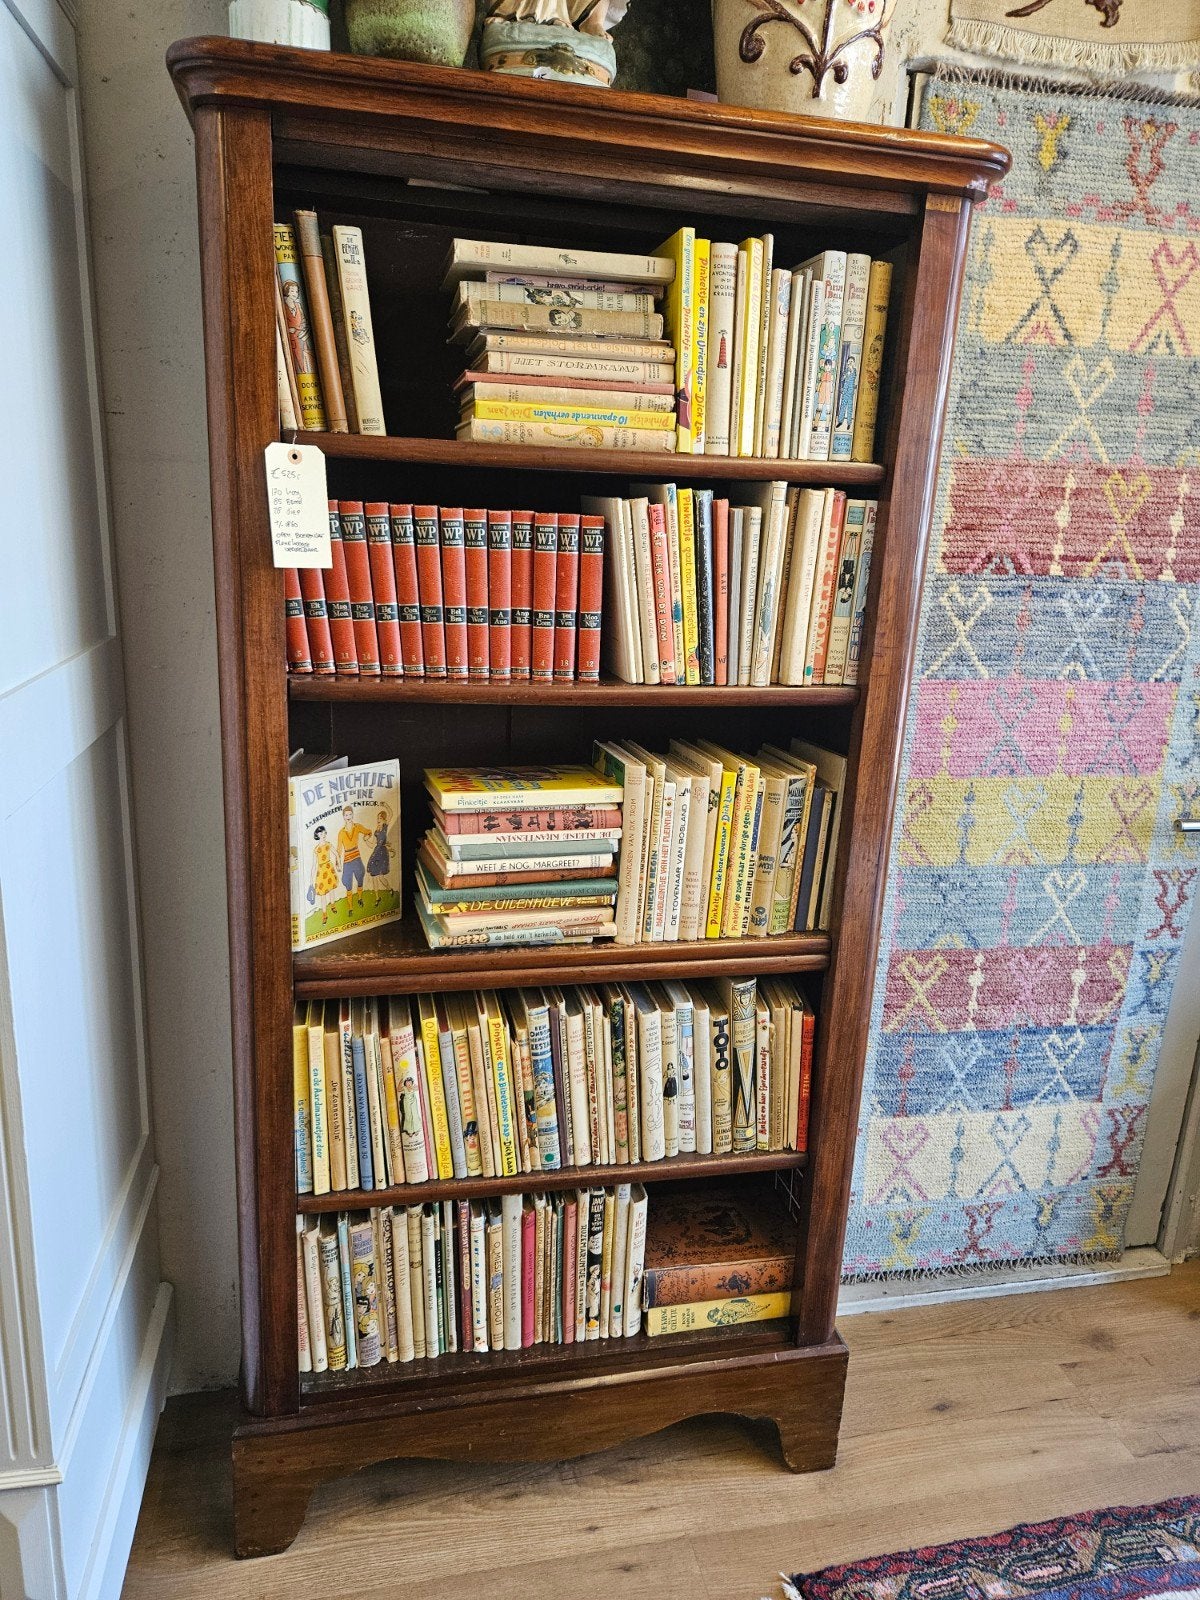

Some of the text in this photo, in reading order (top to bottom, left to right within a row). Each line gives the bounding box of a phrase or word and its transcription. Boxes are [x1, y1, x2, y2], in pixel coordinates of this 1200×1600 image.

[699, 258, 708, 304] Pinkeltje
[683, 308, 691, 350] Pinkeltje
[697, 320, 706, 338] zijn
[695, 393, 705, 418] Dick
[533, 410, 570, 420] verhalen
[571, 412, 618, 423] spannende
[618, 416, 628, 425] 10
[682, 495, 692, 542] Pinkeltje
[343, 522, 363, 533] WP
[369, 524, 388, 535] WP
[394, 525, 413, 536] WP
[416, 527, 436, 538] WP
[444, 528, 462, 539] WP
[466, 529, 485, 540] WP
[491, 530, 509, 542] WP
[515, 531, 532, 542] WP
[537, 533, 555, 545] WP
[560, 534, 578, 545] WP
[584, 535, 602, 546] WP
[683, 547, 691, 566] gaat
[655, 554, 668, 642] HEK VAN DE DAM
[814, 579, 833, 656] TROM
[302, 772, 395, 806] DE NICHTJES
[329, 789, 374, 806] JET INE
[495, 834, 559, 842] KRANTENMAN
[563, 832, 596, 840] KLEINE
[718, 826, 727, 857] tovenaar
[672, 867, 682, 911] TOVENAAR
[678, 804, 688, 844] BOSLAND
[739, 852, 746, 861] de
[499, 863, 506, 871] JE
[660, 859, 668, 874] VAN
[737, 862, 745, 878] naar
[716, 874, 723, 882] de
[646, 882, 655, 910] NIEUW
[735, 894, 742, 902] op
[470, 902, 492, 911] DE
[710, 892, 722, 926] Pinkeltje
[731, 903, 741, 931] Pinkeltje
[307, 929, 339, 941] ALKMAAR
[439, 934, 490, 946] Wietze
[493, 1023, 504, 1060] Pinkeltje
[713, 1019, 730, 1070] TOTO
[498, 1062, 505, 1071] en
[313, 1078, 320, 1087] de
[498, 1072, 506, 1082] de
[504, 1141, 513, 1156] Dick
